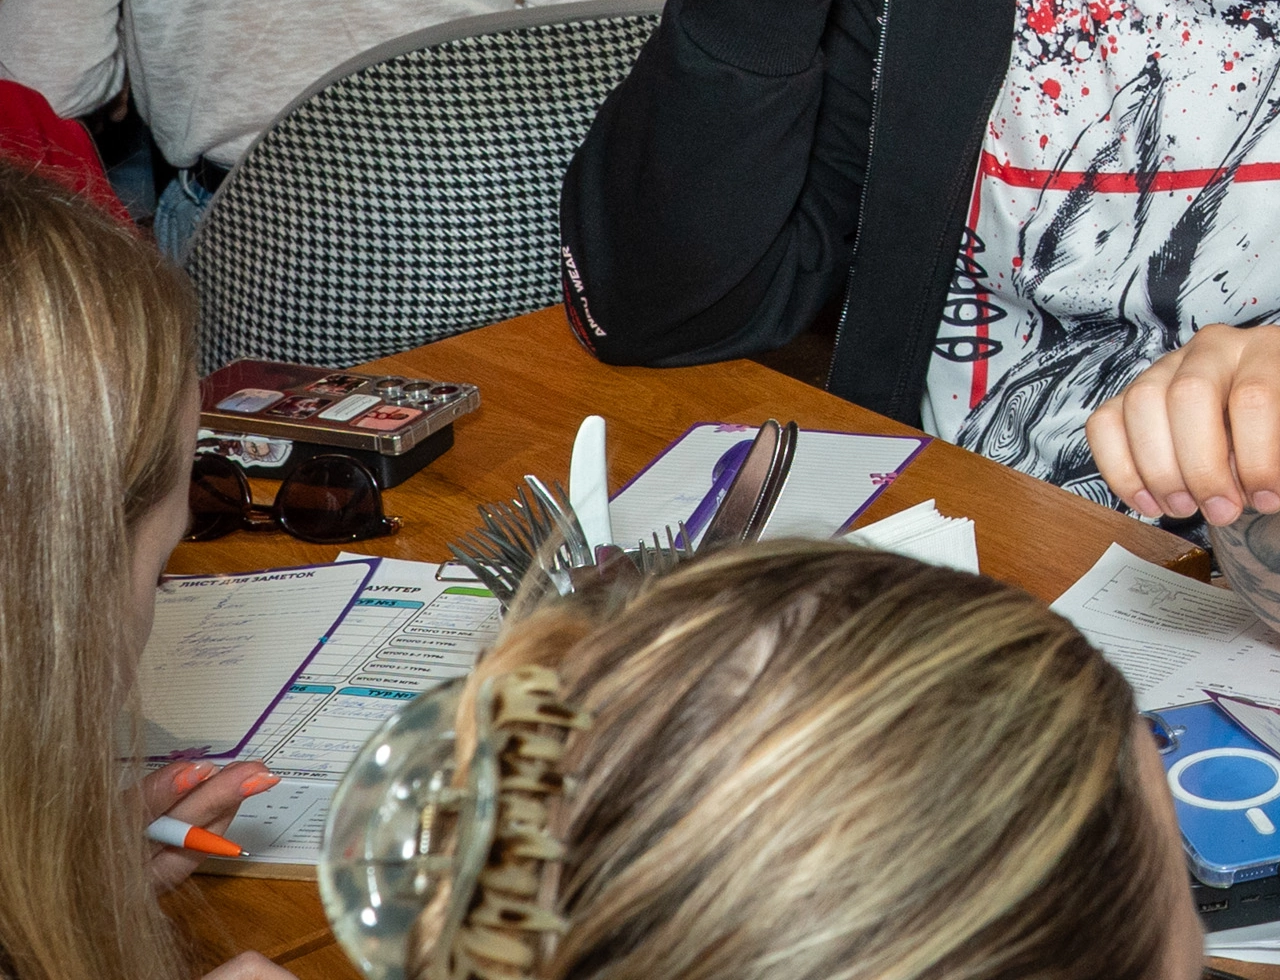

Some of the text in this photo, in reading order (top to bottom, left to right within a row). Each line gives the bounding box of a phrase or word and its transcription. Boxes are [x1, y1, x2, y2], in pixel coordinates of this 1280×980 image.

[562, 246, 584, 293] WEAR
[179, 571, 316, 588] ЛИСТ ДЛЯ ЗАМЕТОК
[362, 585, 421, 593] АУНТЕР
[368, 689, 393, 697] ТУР
